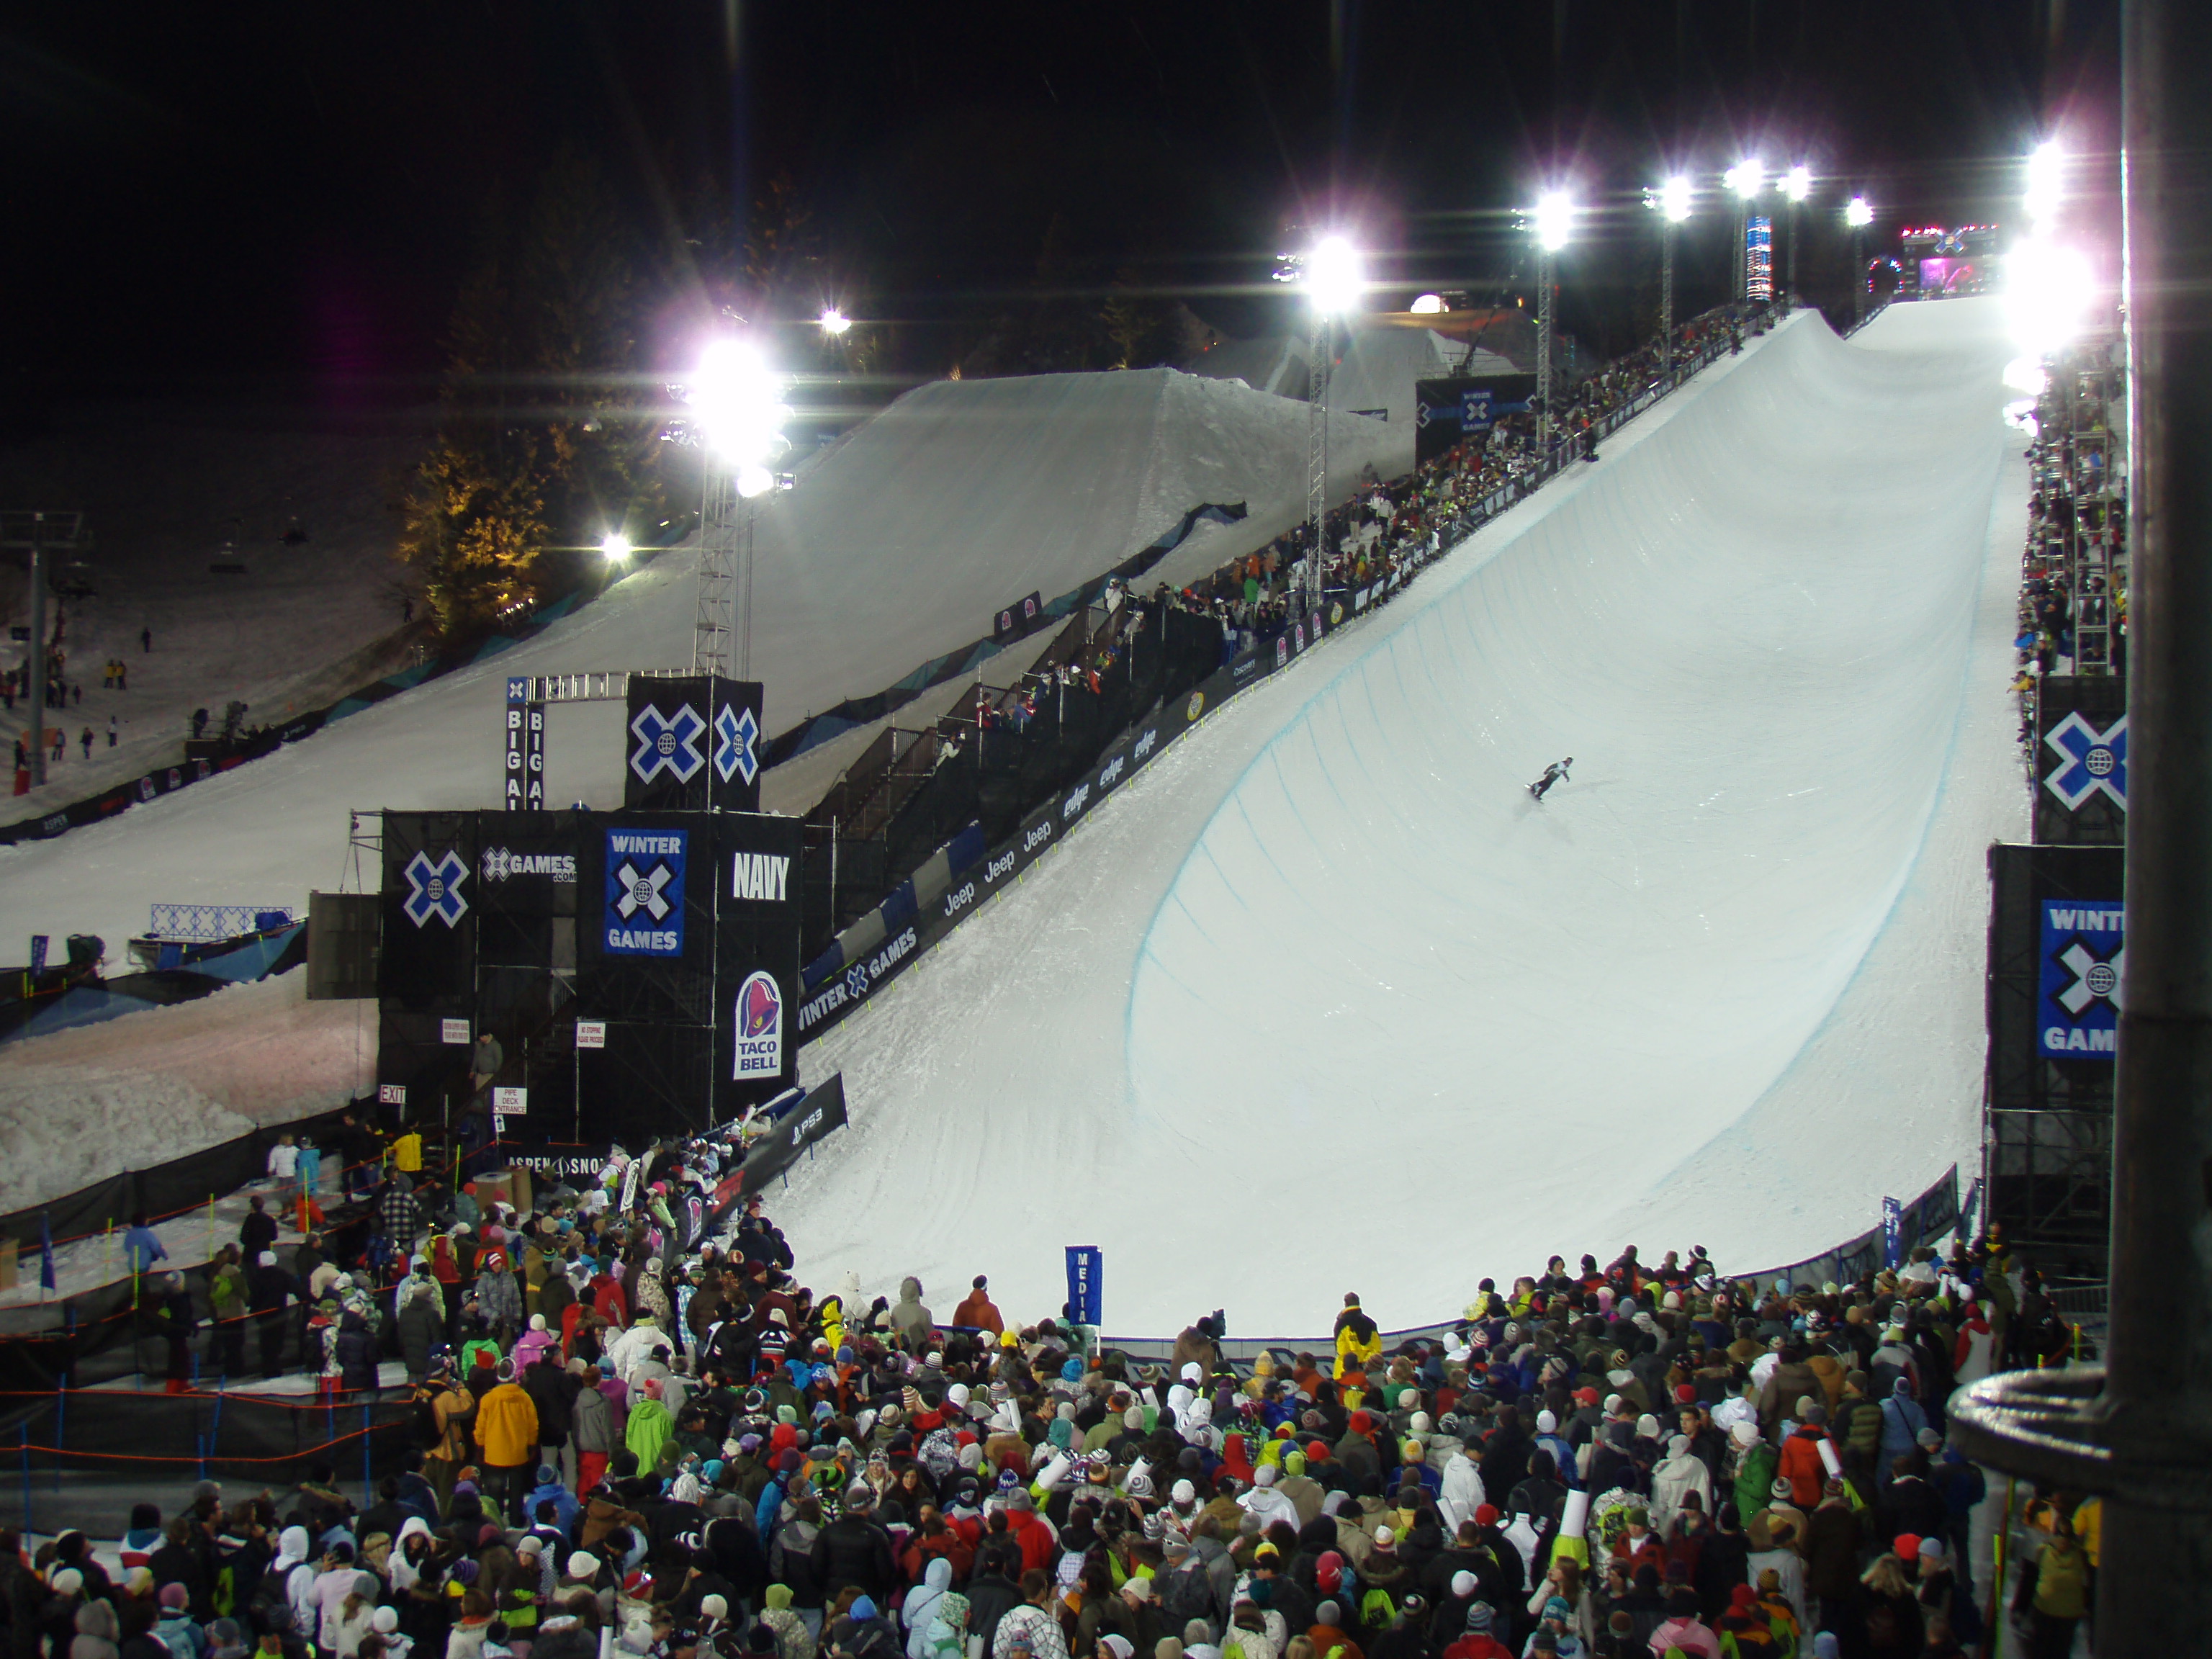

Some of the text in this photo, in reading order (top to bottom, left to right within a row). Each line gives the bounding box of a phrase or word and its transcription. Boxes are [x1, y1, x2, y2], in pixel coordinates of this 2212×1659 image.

[507, 710, 522, 811] BIG AI
[529, 712, 543, 811] BIG AI
[1064, 783, 1089, 818] edge
[612, 835, 681, 854] WINTER
[1023, 822, 1051, 853] Jeep
[510, 855, 576, 873] GAMES
[733, 852, 790, 901] NAVY
[984, 850, 1015, 884] Jeep
[944, 882, 975, 917] Jeep
[608, 929, 678, 951] GAMES
[869, 927, 917, 979] GAMES
[739, 1040, 777, 1056] TACO
[740, 1056, 778, 1071] BELL
[382, 1086, 405, 1103] EXIT
[801, 1107, 823, 1136] PS3
[571, 1157, 604, 1174] SNO
[1078, 1253, 1089, 1322] MEDIA
